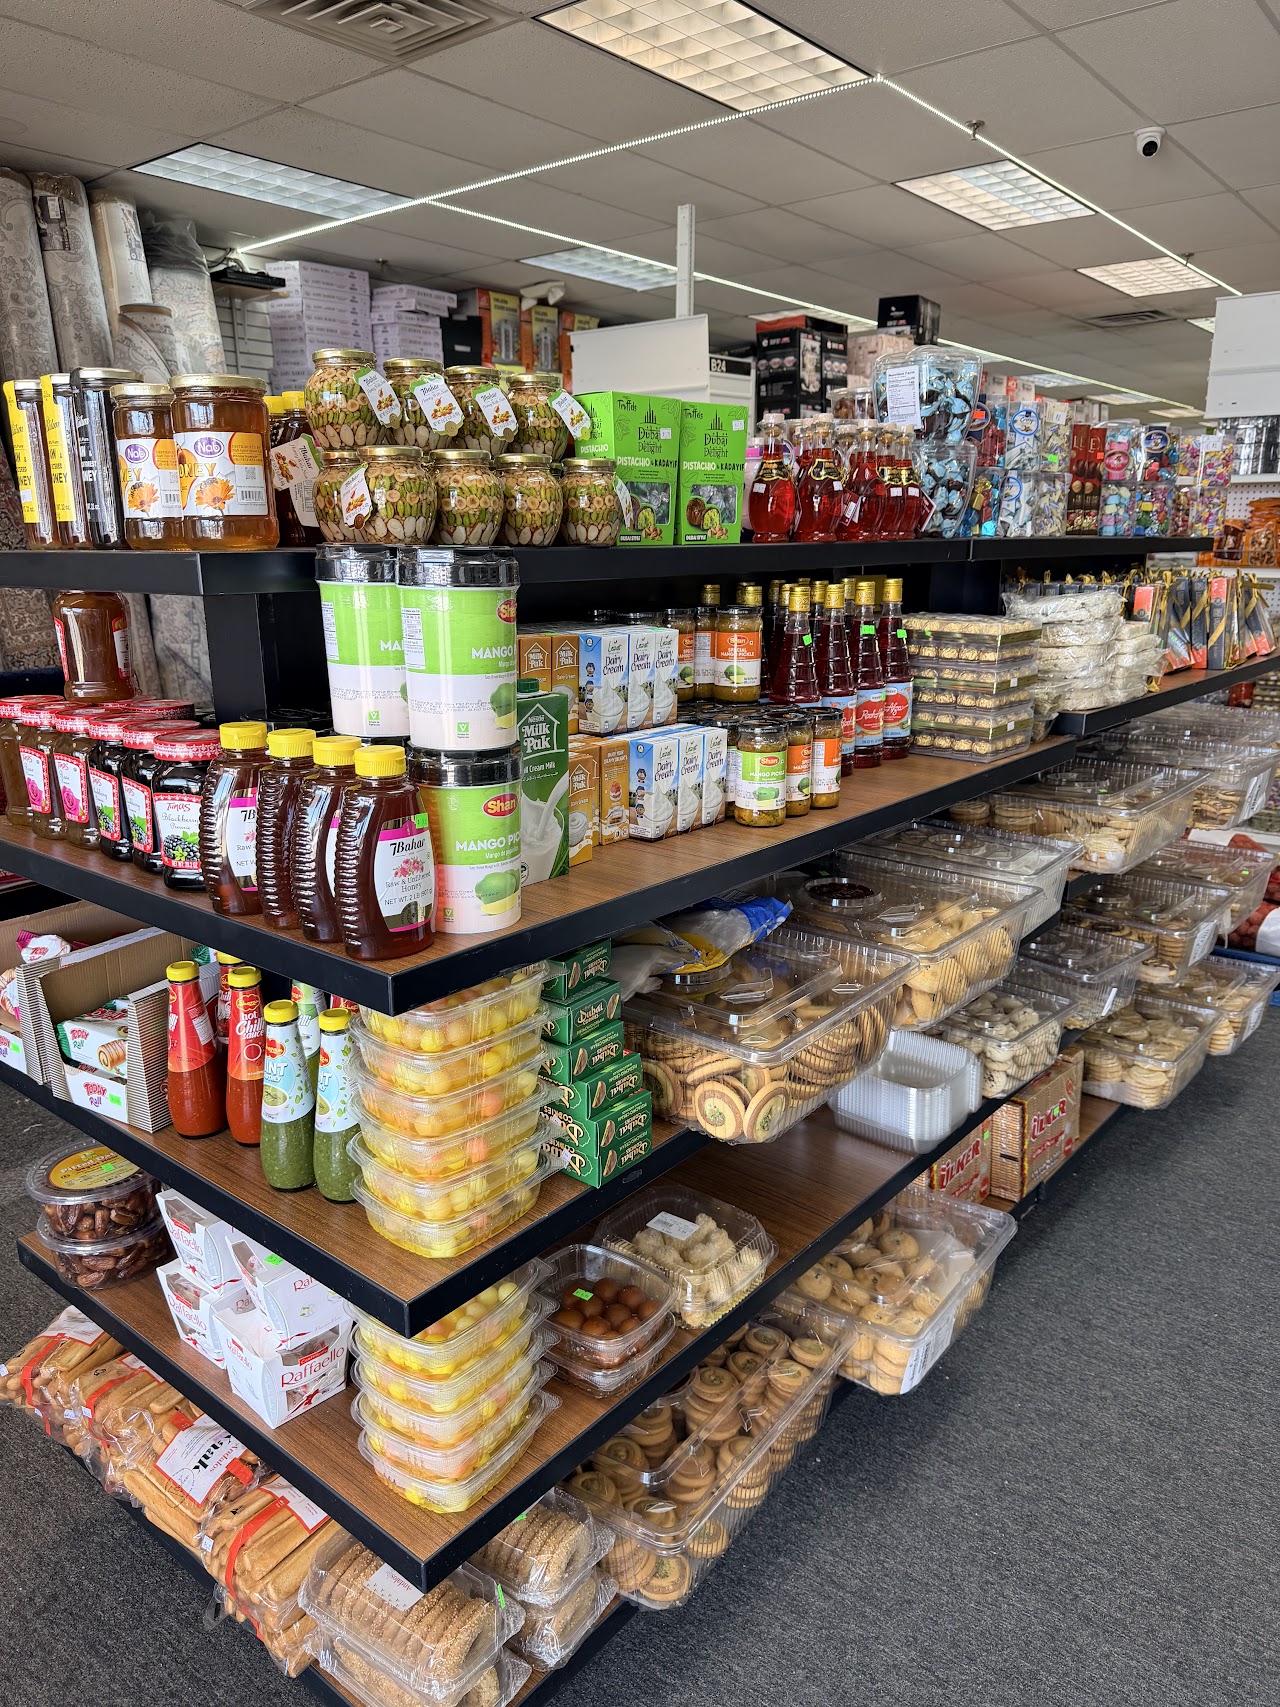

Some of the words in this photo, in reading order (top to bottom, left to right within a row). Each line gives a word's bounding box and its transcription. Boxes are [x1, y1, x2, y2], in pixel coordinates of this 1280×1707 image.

[711, 359, 726, 372] B24
[704, 432, 728, 446] Dubai
[198, 442, 218, 453] Nab
[580, 444, 608, 454] PISTACHIO
[127, 449, 146, 459] Nab
[616, 456, 650, 468] PISTACHIO
[654, 459, 678, 468] KADAYIF
[683, 461, 716, 471] PISTACHIO
[720, 463, 745, 471] KADAYIF
[121, 468, 142, 481] NEY
[179, 463, 216, 478] ONEY
[501, 602, 516, 618] Sha
[380, 640, 402, 650] MA
[472, 646, 512, 659] MANGO
[559, 650, 573, 658] Milk
[634, 652, 650, 663] Dairy
[658, 650, 673, 660] Dairy
[529, 660, 544, 668] Pak
[560, 656, 573, 665] Pak
[606, 655, 622, 666] Dairy
[656, 659, 674, 669] Cream
[603, 664, 624, 676] Cream
[631, 662, 651, 672] Cream
[522, 722, 550, 738] Milk
[523, 734, 551, 754] Pak
[683, 755, 698, 766] Dairy
[708, 750, 722, 760] Dairy
[529, 764, 544, 772] Cream
[546, 761, 556, 770] Milk
[657, 760, 674, 774] Dairy
[706, 759, 723, 770] Cream
[760, 757, 778, 766] Shan
[654, 770, 674, 782] Cream
[680, 764, 700, 776] Cream
[573, 774, 586, 782] Milk
[573, 781, 586, 791] Pak
[488, 798, 516, 814] Shan
[162, 813, 198, 825] Blackberry
[389, 838, 426, 856] 7Bahar
[456, 837, 506, 852] MANGO
[508, 832, 520, 846] PIC
[486, 851, 500, 859] Mango
[386, 880, 400, 888] Raw
[407, 872, 430, 884] Unfiltered
[401, 882, 422, 893] Honey
[420, 890, 428, 898] (907
[584, 960, 607, 979] Dubai
[241, 1011, 258, 1020] hot
[578, 1002, 603, 1023] Dubai
[235, 1018, 265, 1035] Chilli
[70, 1029, 90, 1041] TODAY
[242, 1029, 264, 1040] sauce
[592, 1044, 618, 1065] Dubai
[265, 1062, 288, 1076] INT
[84, 1082, 107, 1096] TODAY
[610, 1076, 637, 1097] Dubai
[89, 1096, 102, 1108] Roll
[620, 1114, 647, 1136] Dubai
[621, 1142, 648, 1164] Dubai
[60, 1160, 94, 1174] Pitted
[96, 1152, 115, 1161] Dat
[167, 1221, 203, 1256] Raffaello
[167, 1294, 207, 1330] Raffaello
[282, 1347, 344, 1388] Raffaello
[210, 1443, 239, 1474] Andalos
